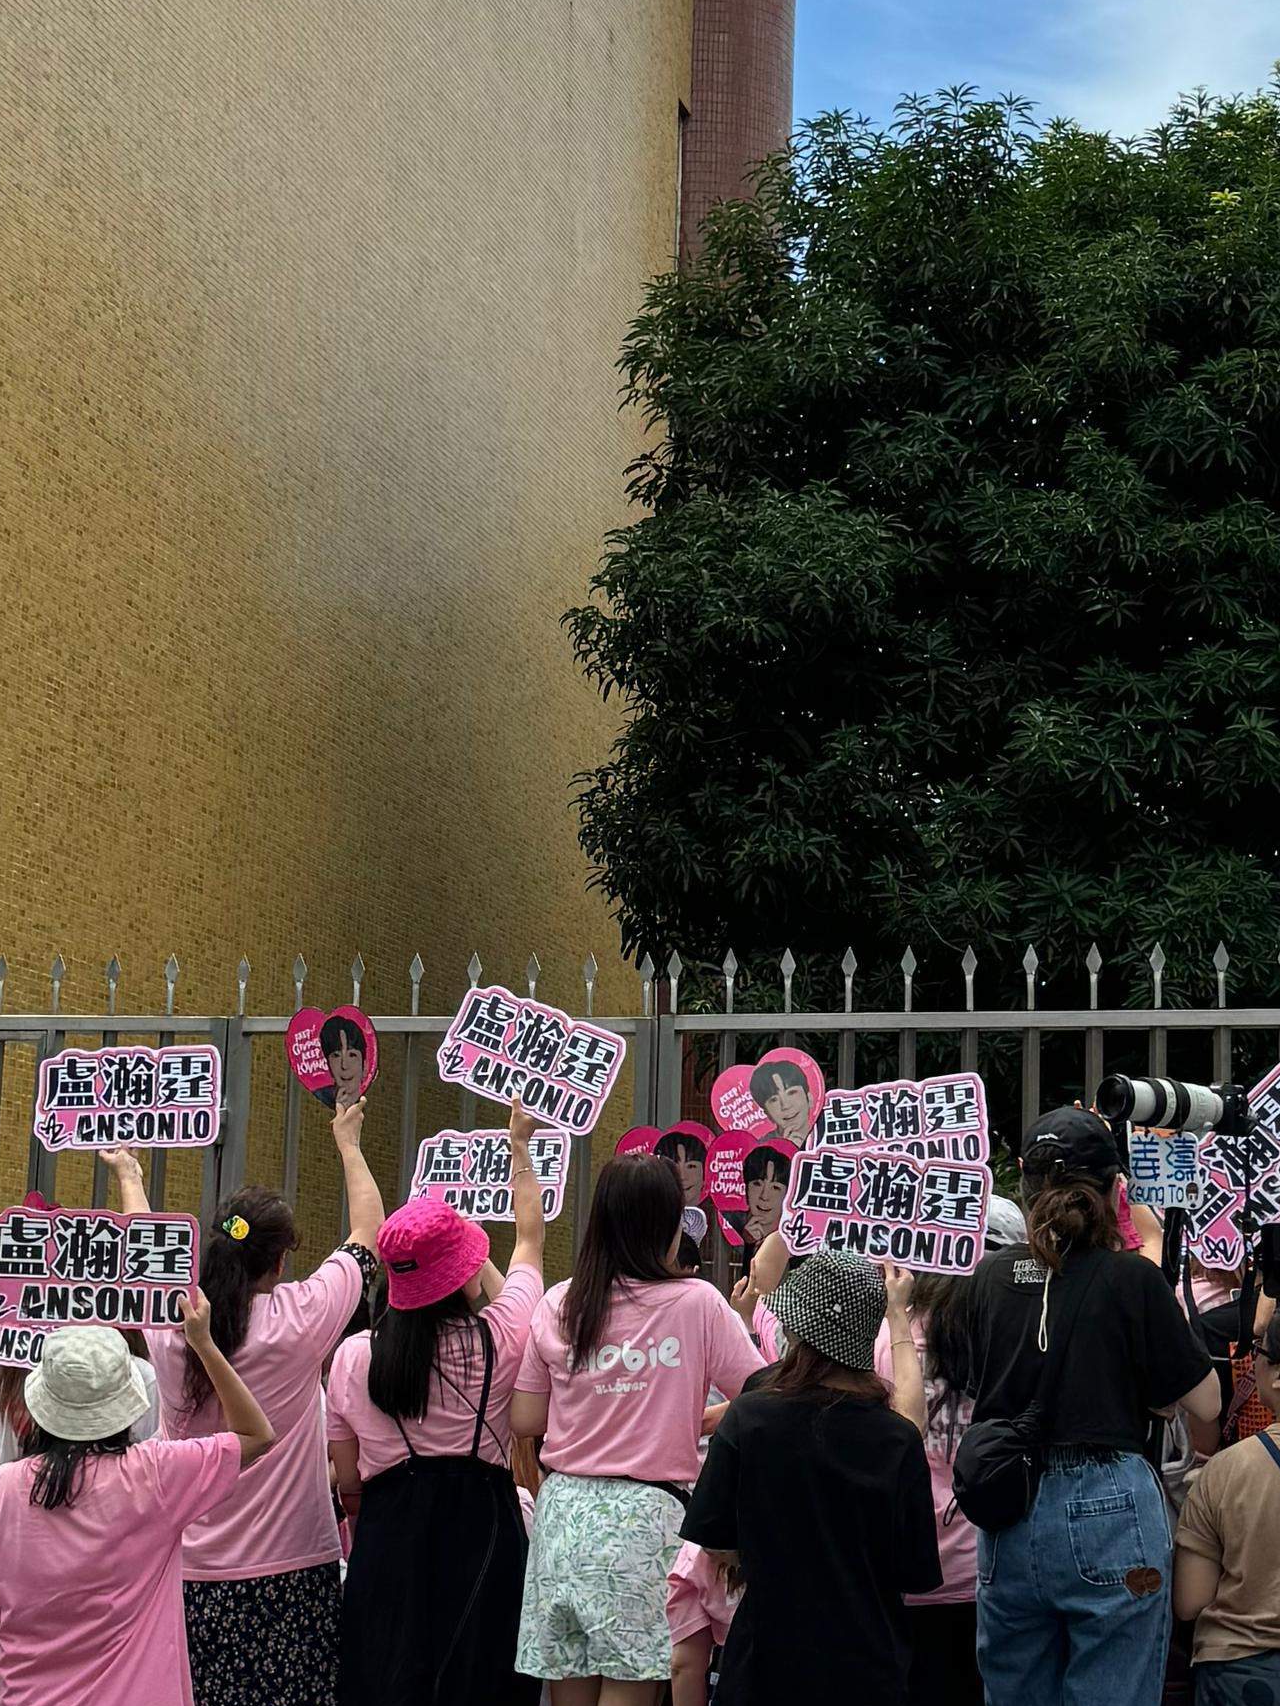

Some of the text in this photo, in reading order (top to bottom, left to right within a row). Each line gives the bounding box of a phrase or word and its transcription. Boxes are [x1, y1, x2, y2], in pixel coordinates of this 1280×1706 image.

[457, 995, 618, 1096] 盧瀚霆
[46, 1055, 213, 1107] 盧瀚霆
[472, 1055, 563, 1117] ANSON
[561, 1092, 593, 1127] LO
[76, 1111, 175, 1142] ANSON
[182, 1110, 211, 1140] LO
[816, 1084, 981, 1147] 盧瀚霆
[444, 1188, 517, 1215] ANSO
[794, 1154, 984, 1231] 盧瀚霆
[1168, 1184, 1184, 1204] To
[826, 1219, 934, 1264] ANSON
[941, 1233, 975, 1268] LO
[20, 1285, 145, 1323] ANSON
